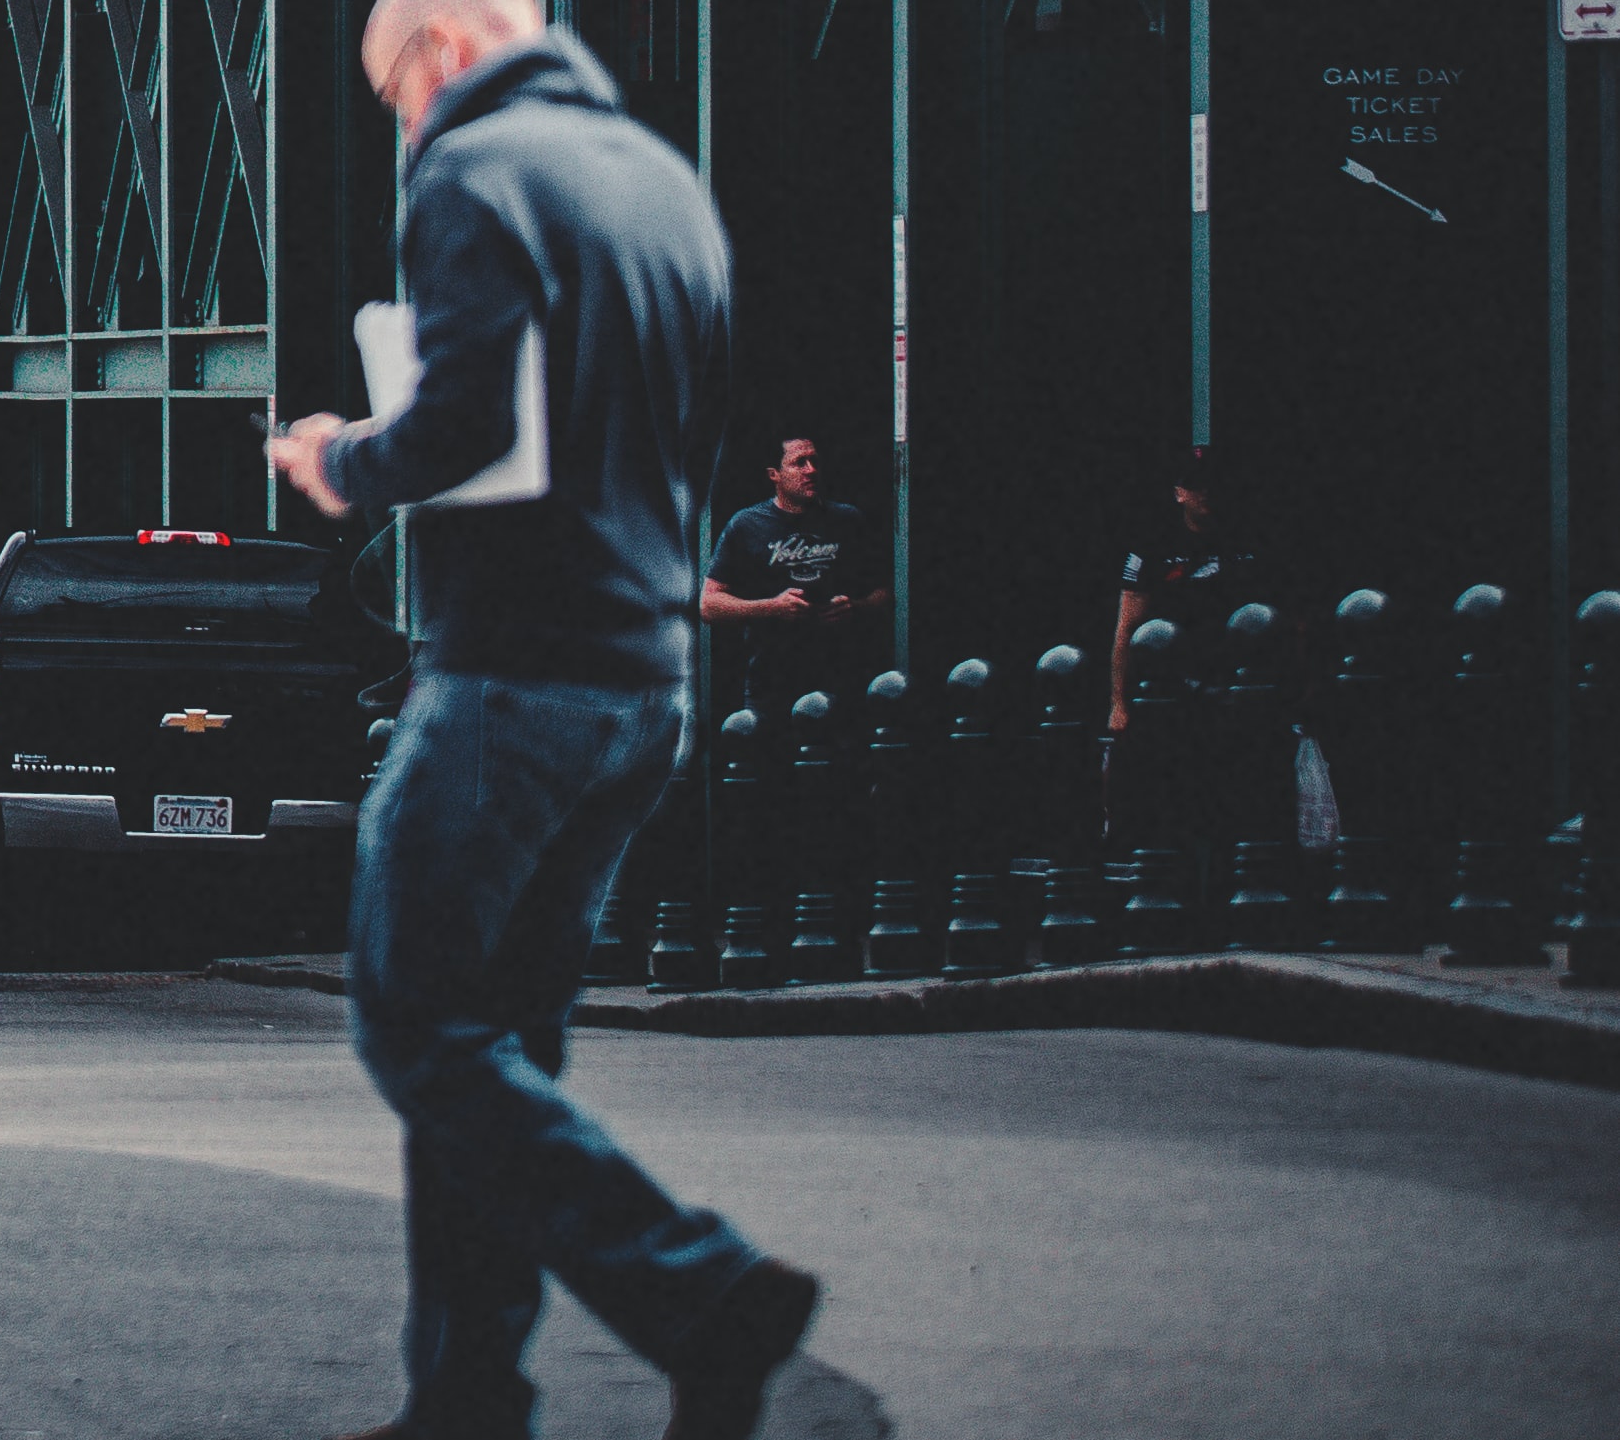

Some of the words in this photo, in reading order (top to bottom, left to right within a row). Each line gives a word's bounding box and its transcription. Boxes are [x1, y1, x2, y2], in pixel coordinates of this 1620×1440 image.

[1322, 67, 1401, 85] GAME
[1417, 68, 1465, 85] DAY
[1346, 96, 1442, 115] TICKET
[1349, 125, 1438, 144] SALES
[158, 807, 190, 828] 6ZM
[195, 807, 228, 828] 736
